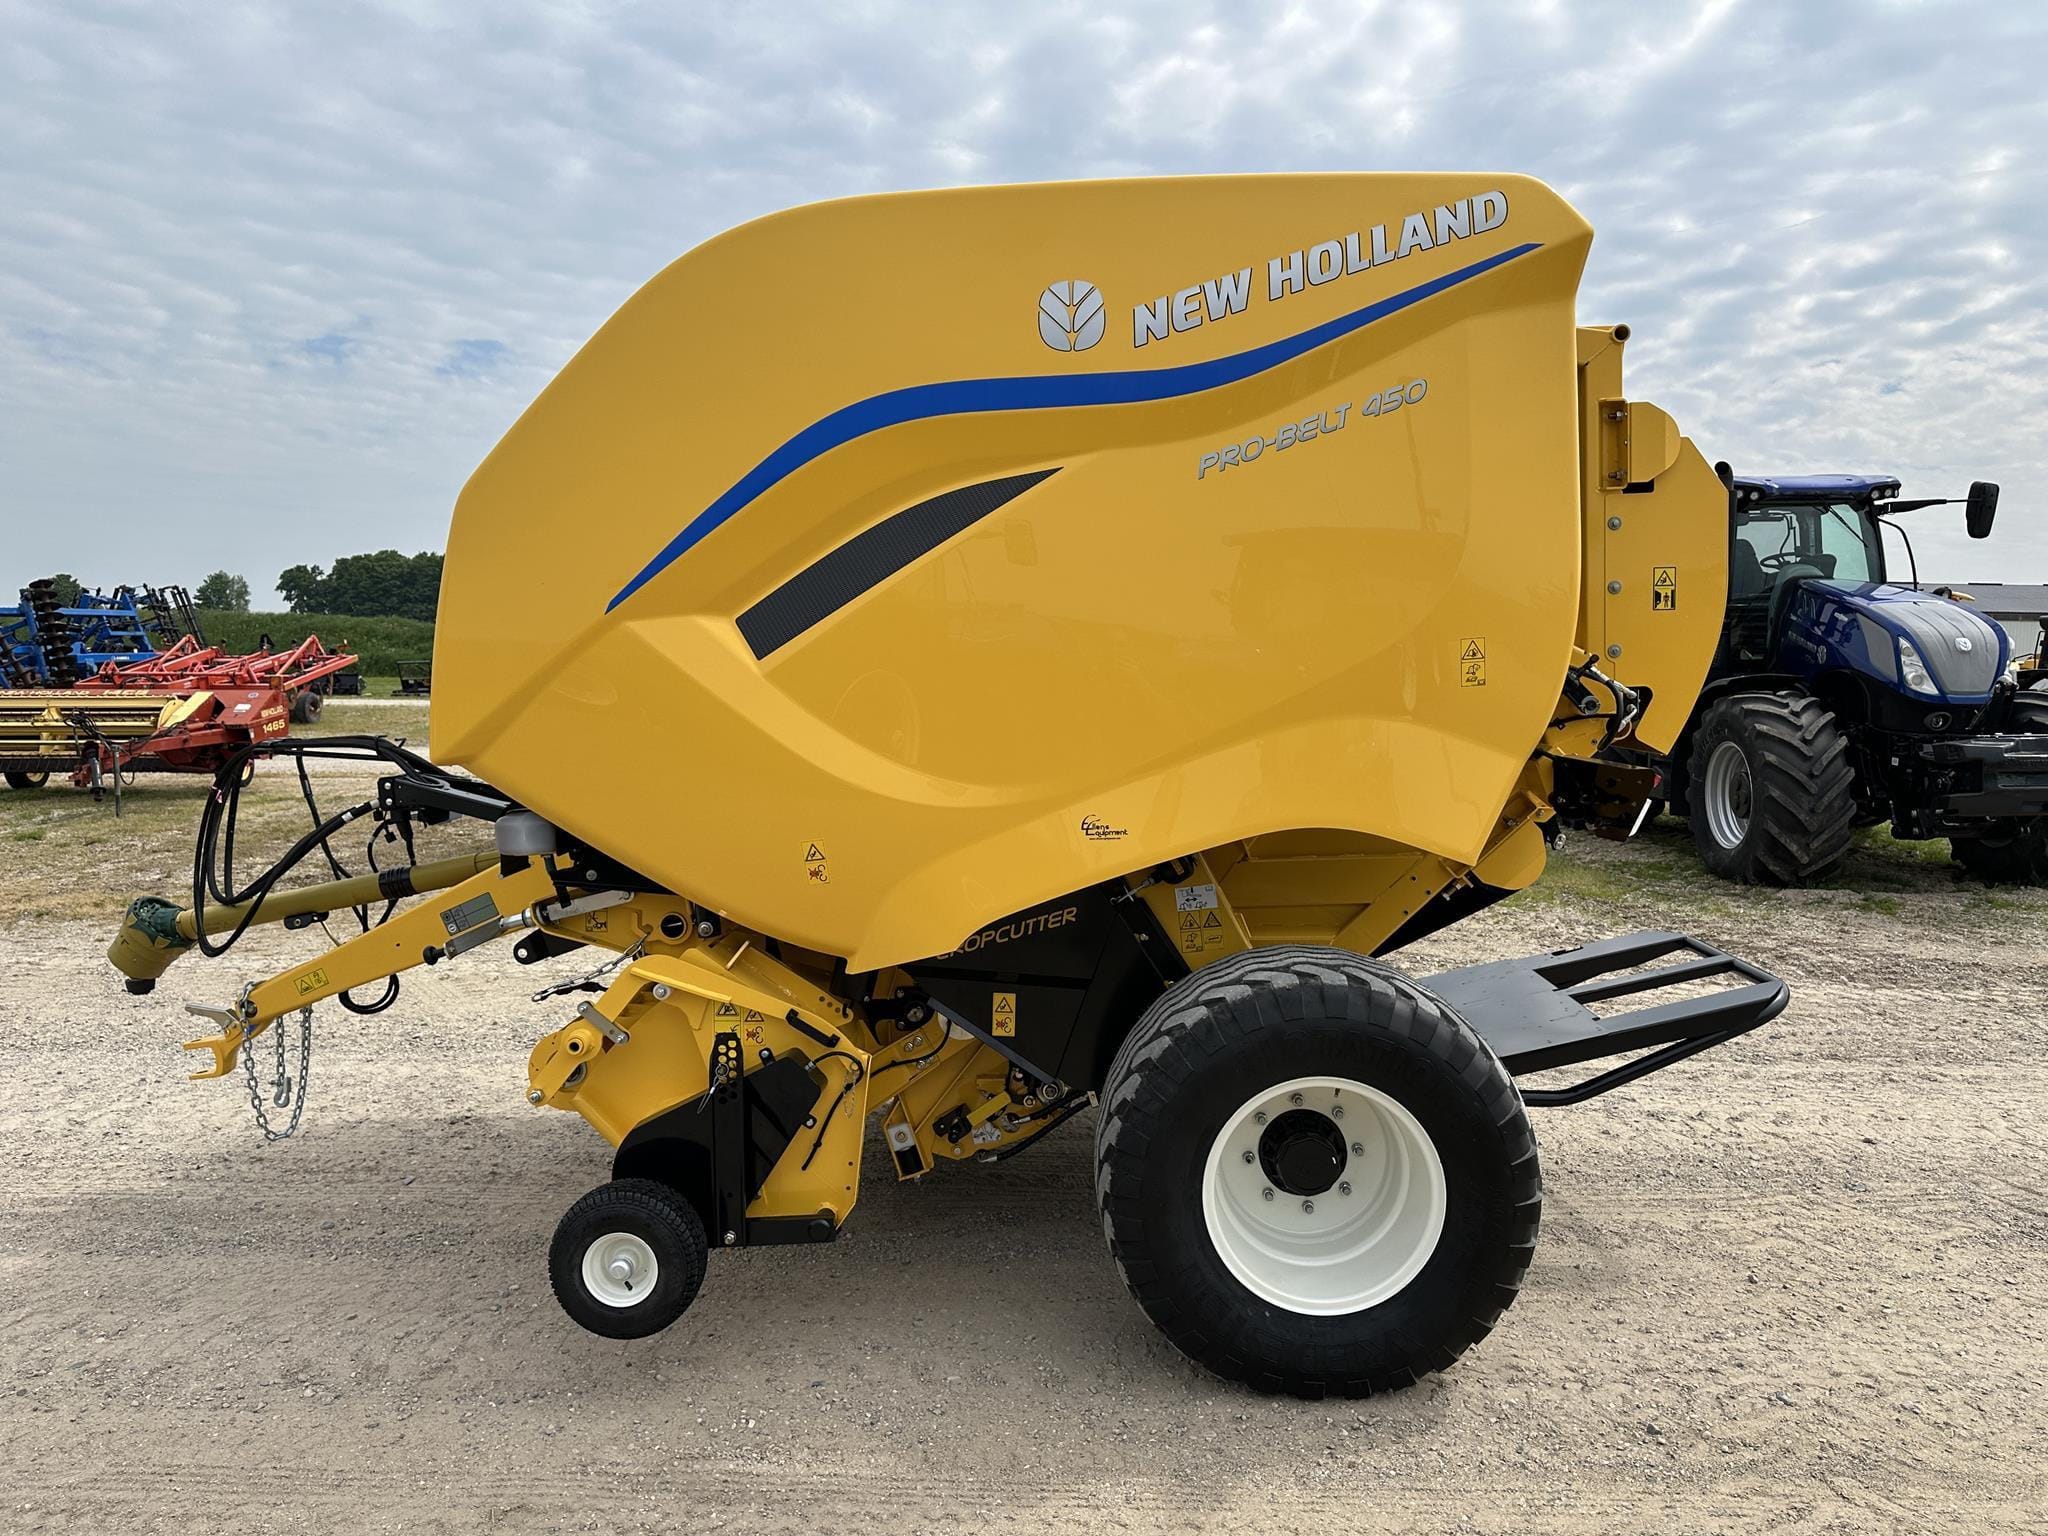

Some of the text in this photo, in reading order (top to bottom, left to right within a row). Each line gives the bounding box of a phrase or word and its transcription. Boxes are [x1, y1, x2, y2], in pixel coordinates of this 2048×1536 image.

[1133, 189, 1509, 348] NEW HOLLAND
[1198, 378, 1428, 480] PRO-BELT 450
[262, 718, 286, 734] 1465
[936, 907, 1078, 960] OPCUTTER
